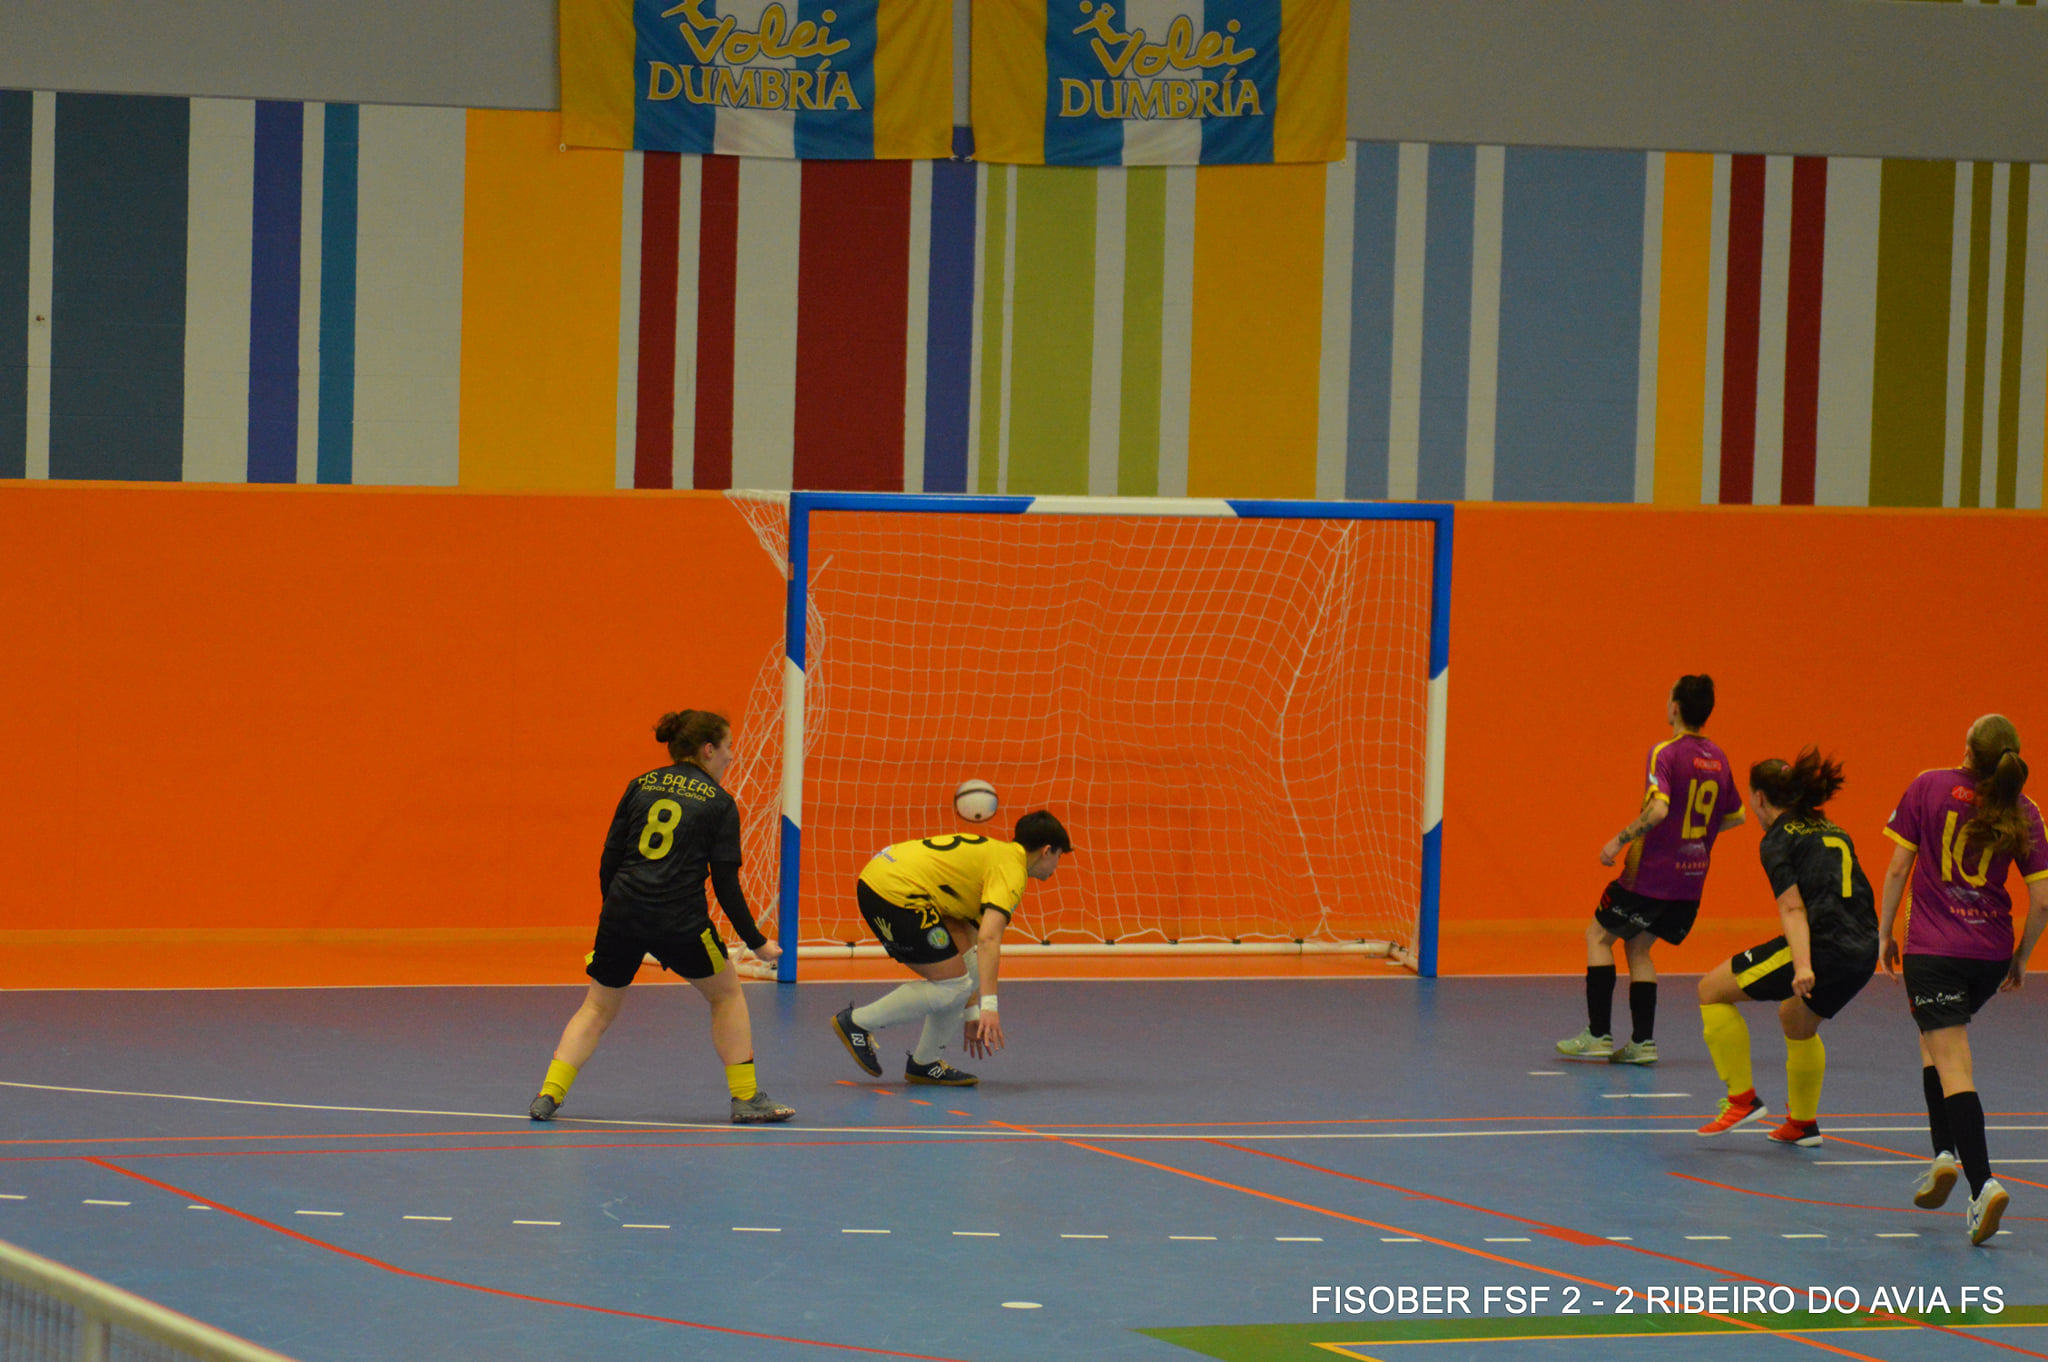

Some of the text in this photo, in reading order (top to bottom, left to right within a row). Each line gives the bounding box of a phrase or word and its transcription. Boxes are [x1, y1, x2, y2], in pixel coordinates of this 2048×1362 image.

[679, 2, 851, 66] Volei
[1090, 14, 1257, 78] Volei
[647, 59, 862, 111] DUMBRÍA
[1059, 68, 1265, 121] DUMBRÍA
[662, 773, 717, 798] BALEAS
[1681, 778, 1719, 840] 19
[638, 798, 683, 861] 8
[1821, 835, 1853, 899] 7
[914, 907, 941, 931] 23
